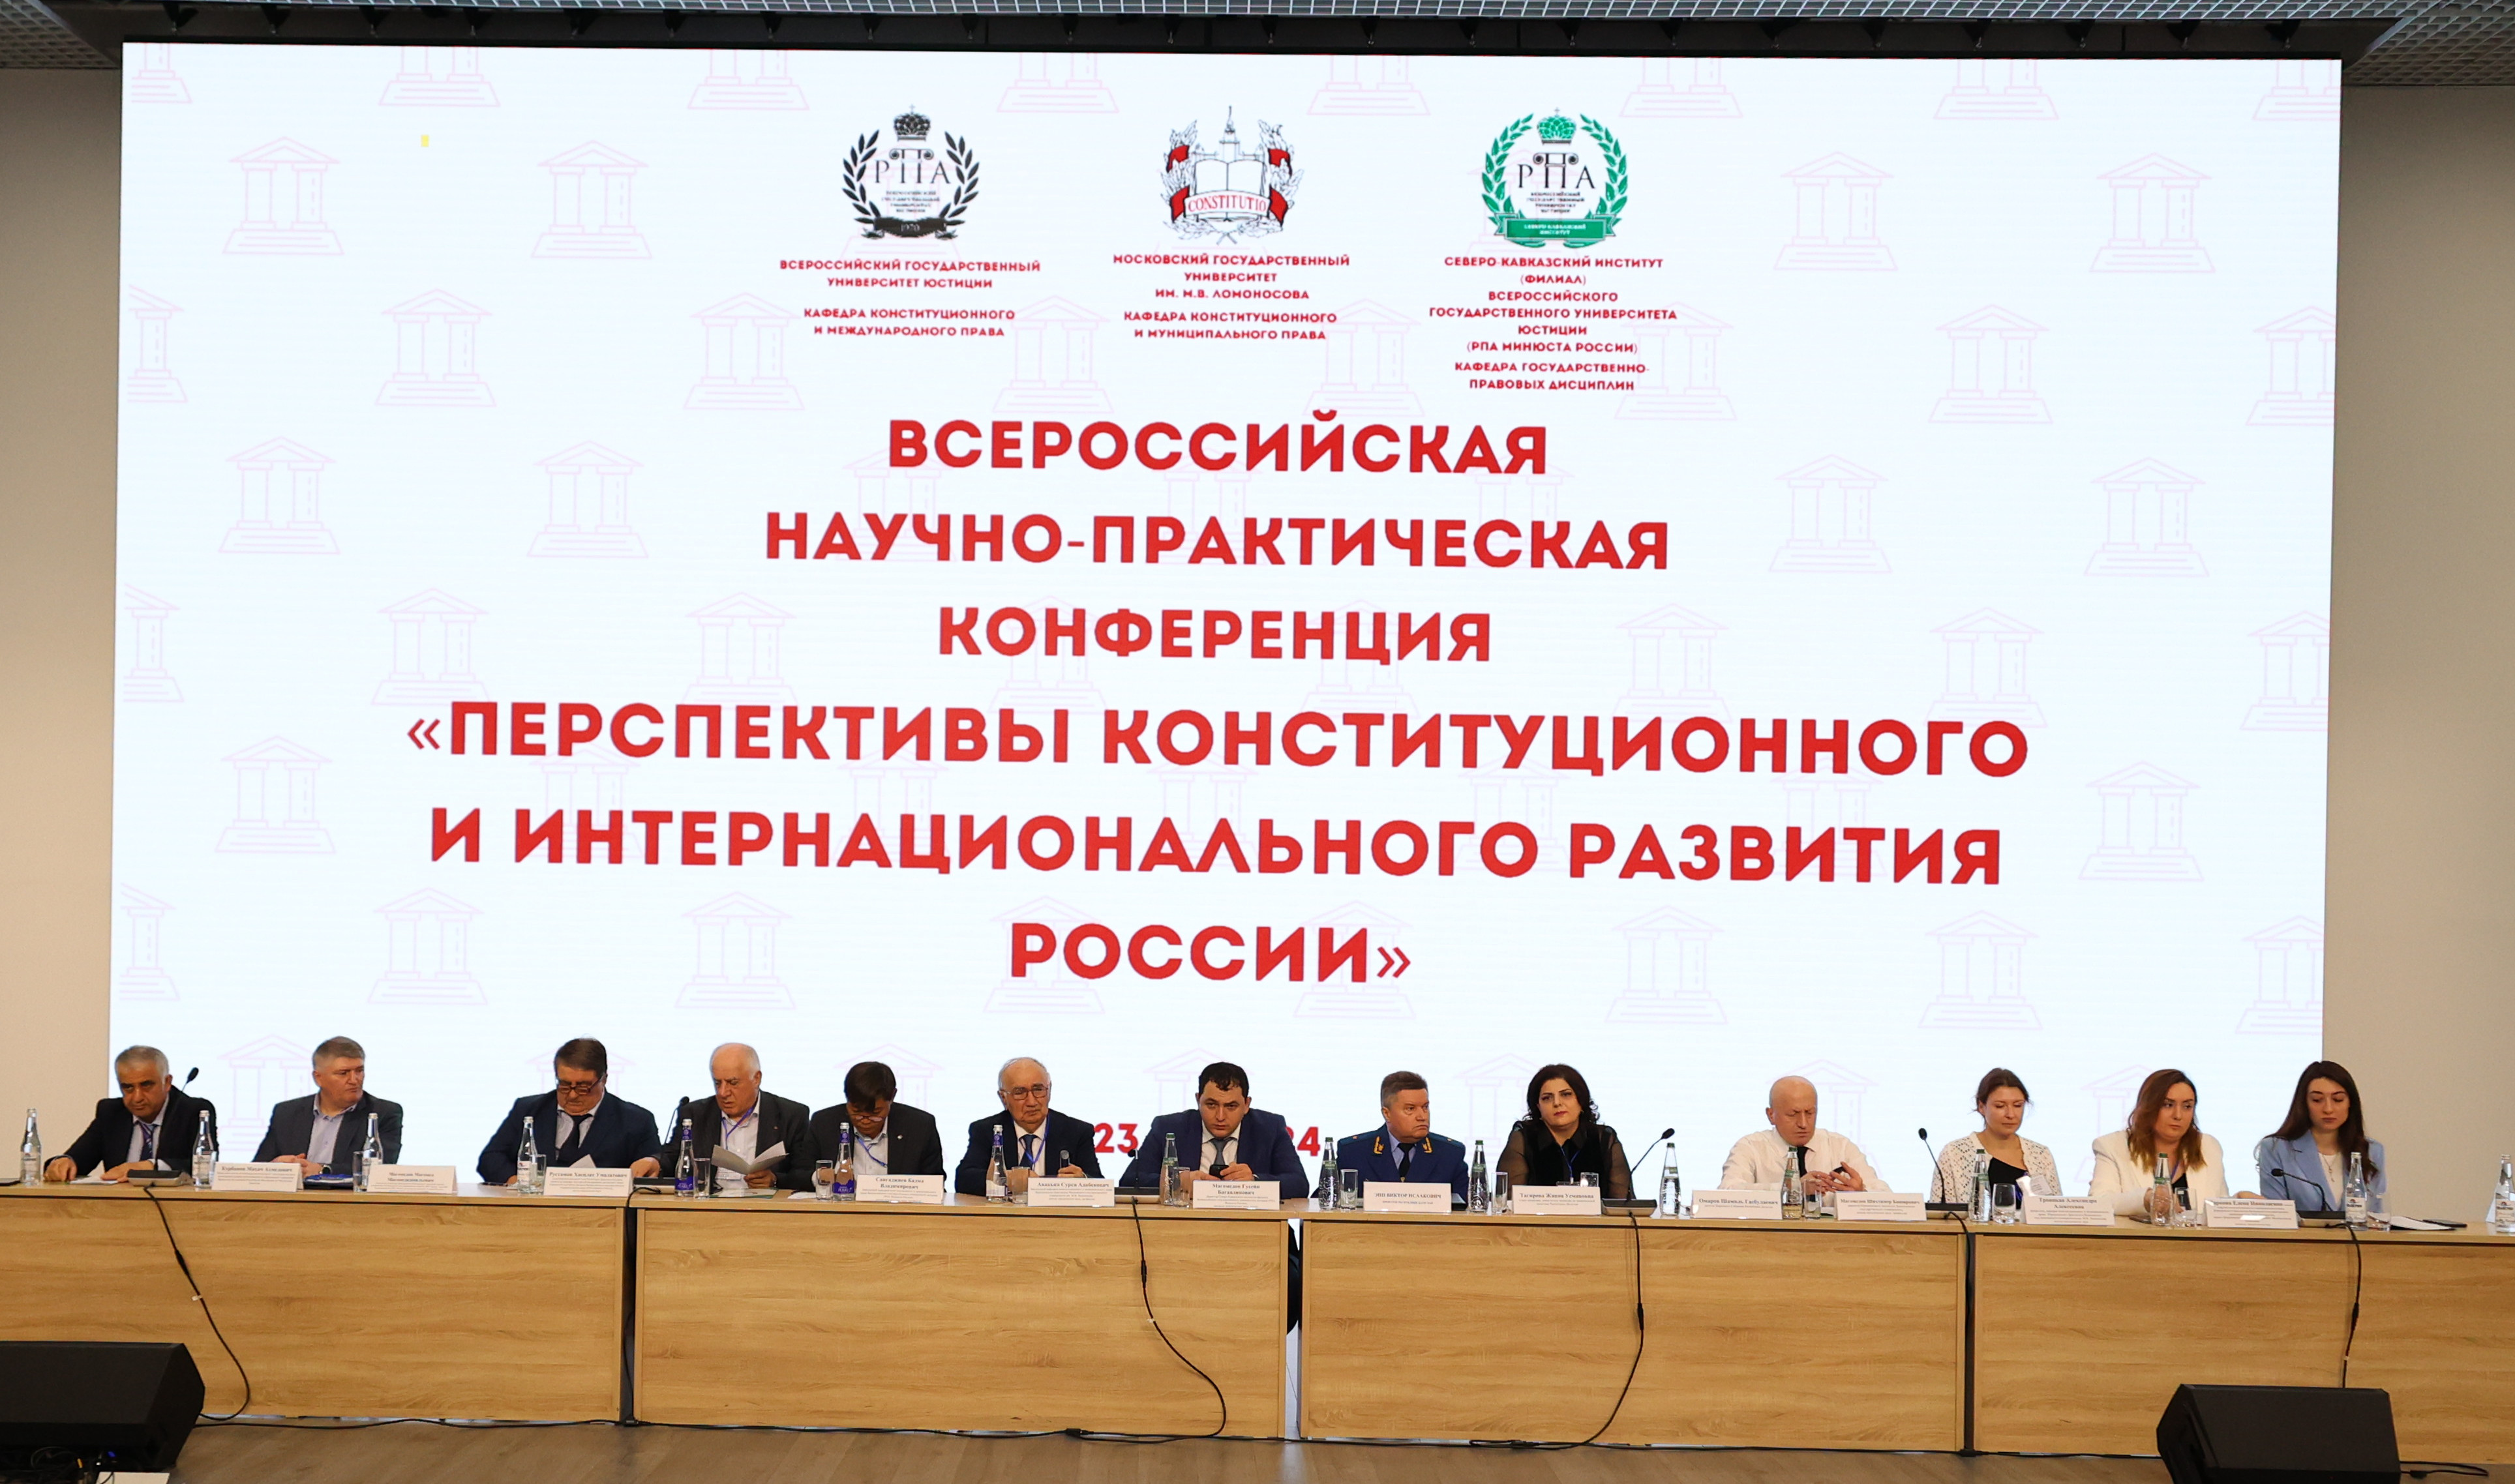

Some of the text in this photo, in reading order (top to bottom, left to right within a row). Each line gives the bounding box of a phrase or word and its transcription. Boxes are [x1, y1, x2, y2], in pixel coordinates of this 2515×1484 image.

[1188, 195, 1267, 212] CONSTITUTIO
[779, 258, 1040, 272] ВСЕРОССИЙСКИЙ ГОСУДАРСТВЕННЫЙ
[1113, 253, 1350, 266] МОСКОВСКИЙ ГОСУДАРСТВЕННЫЙ
[1445, 256, 1664, 268] СЕВЕРО-КАВКАЗСКИЙ ИНСТИТУТ
[828, 278, 993, 289] УНИВЕРСИТЕТ ЮСТИЦИИ
[1184, 273, 1277, 282] УНИВЕРСИТЕТ
[1520, 274, 1587, 286] (ФИЛИАЛ)
[1156, 289, 1310, 299] ИМ. М.В. ЛОМОНОСОВА
[1488, 290, 1619, 302] ВСЕРОССИЙСКОГО
[804, 308, 1016, 320] КАФЕДРА КОНСТИТУЦИОННОГО
[1124, 311, 1338, 323] КАФЕДРА КОНСТИТУЦИОННОГО
[1429, 307, 1678, 319] ГОСУДАРСТВЕННОГО УНИВЕРСИТЕТА
[827, 326, 957, 336] МЕЖДУНАРОДНОГО
[961, 327, 1004, 336] ПРАВА
[1148, 329, 1278, 340] МУНИЦИПАЛЬНОГО
[1282, 330, 1327, 340] ПРАВА
[1518, 325, 1588, 336] ЮСТИЦИИ
[1466, 341, 1638, 354] (РПА МИНЮСТА РОССИИ)
[1454, 362, 1650, 374] КАФЕДРА ГОСУДАРСТВЕННО-
[1469, 379, 1634, 391] ПРАВОВЫХ ДИСЦИПЛИН
[888, 408, 1547, 476] ВСЕРОССИЙСКАЯ
[766, 511, 1668, 571] НАУЧНО-ПРАКТИЧЕСКАЯ
[939, 606, 1491, 666] КОНФЕРЕНЦИЯ
[407, 700, 2030, 779] «ПЕРСПЕКТИВЫ КОНСТИТУЦИОННОГО
[430, 807, 2001, 886] И ИНТЕРНАЦИОНАЛЬНОГО РАЗВИТИЯ
[1010, 921, 1412, 984] РОССИИ»
[1094, 1122, 1139, 1153] 23
